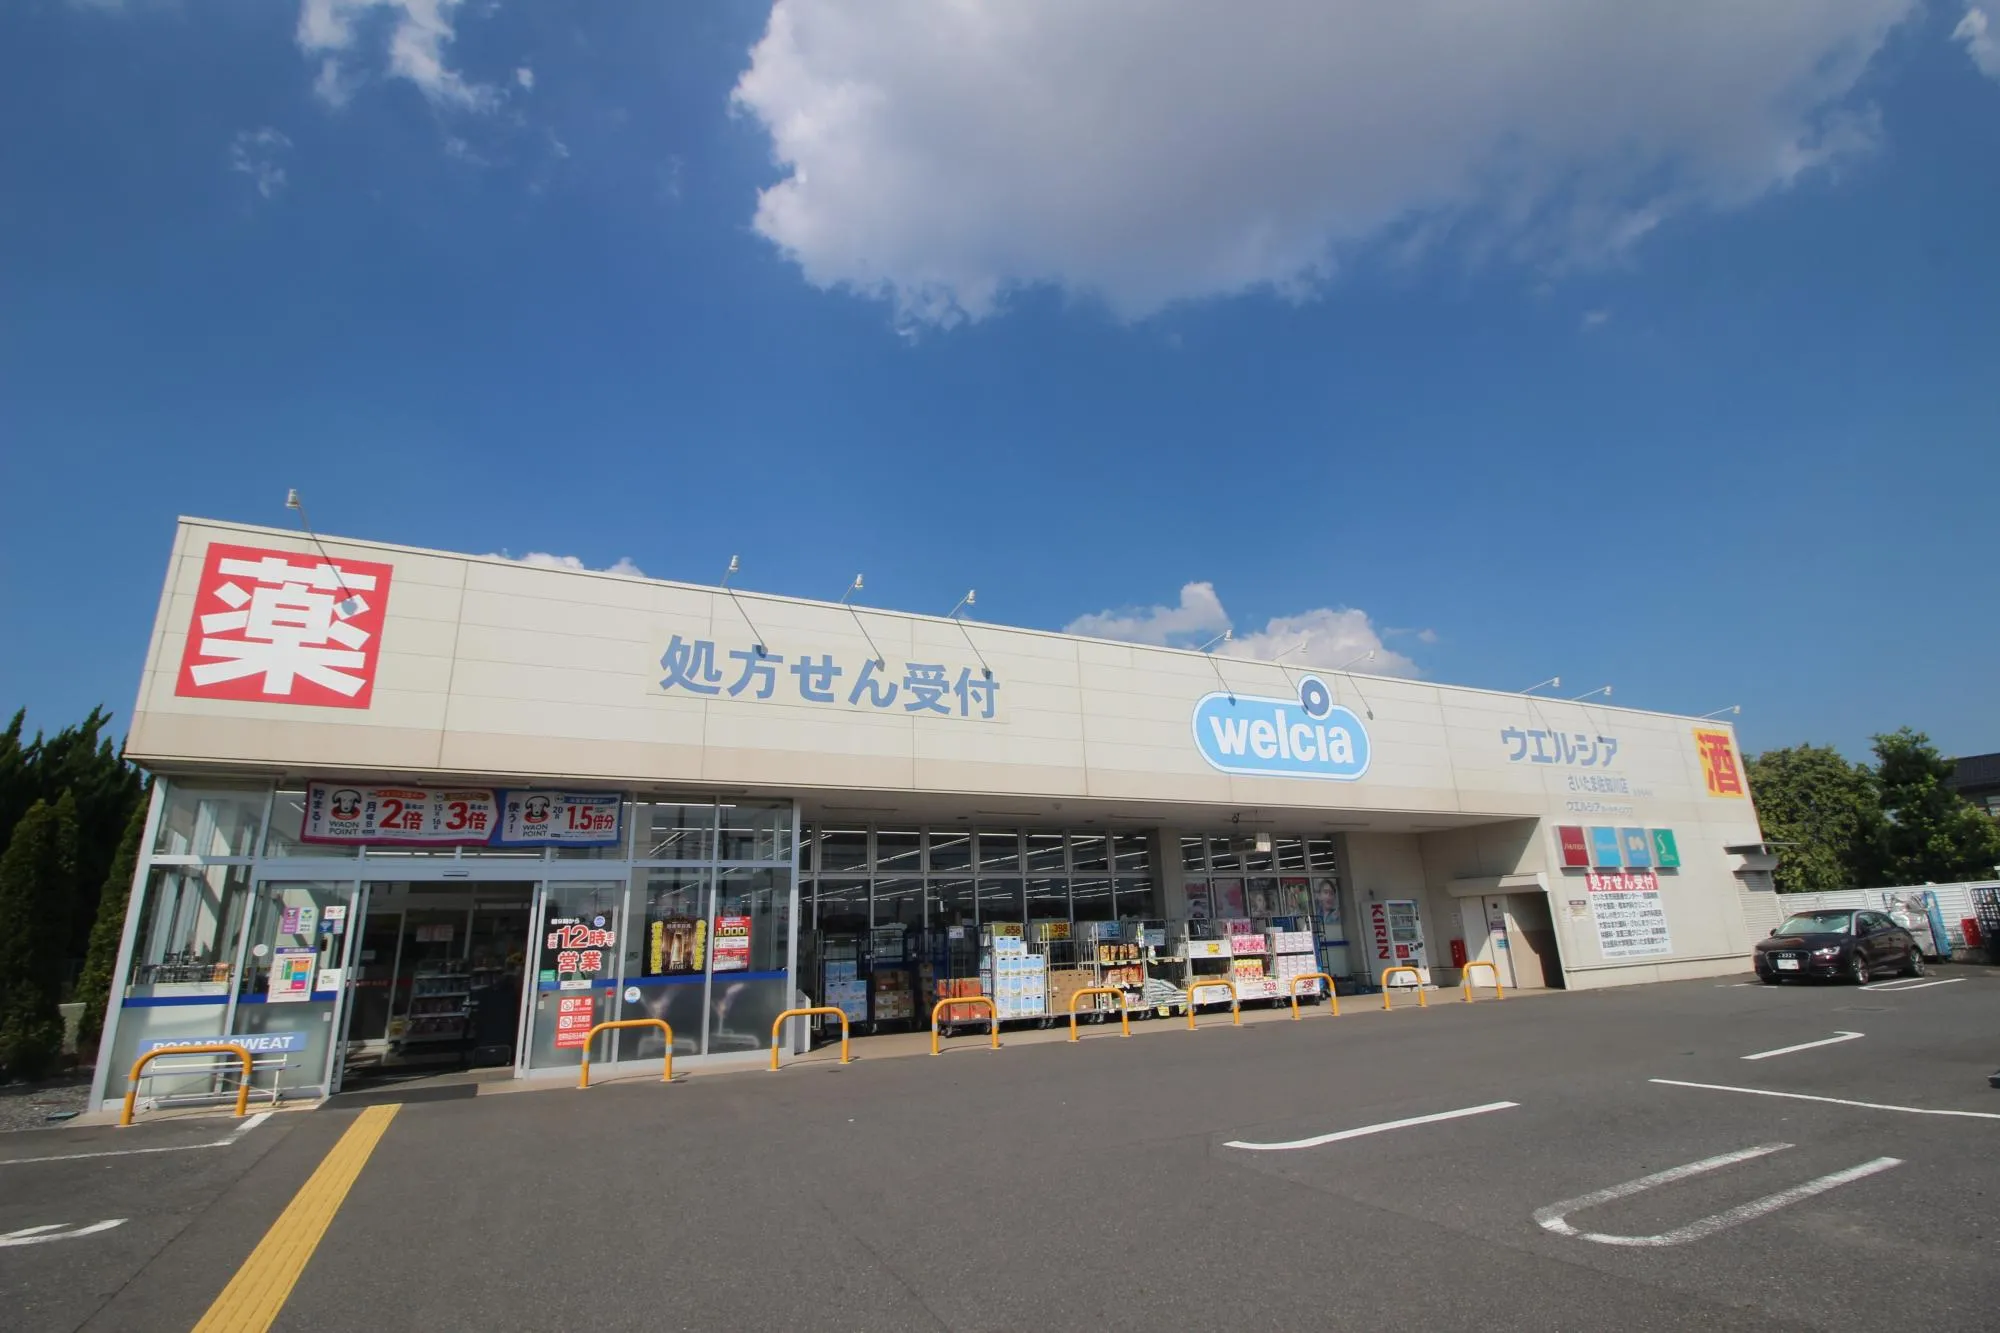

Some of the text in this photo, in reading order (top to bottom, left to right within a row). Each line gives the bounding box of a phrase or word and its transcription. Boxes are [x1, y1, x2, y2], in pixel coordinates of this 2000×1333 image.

[190, 556, 378, 697] 薬
[659, 634, 1001, 719] 処方せん受付
[1209, 708, 1355, 764] welcia
[1500, 726, 1618, 768] ウエルシア
[1697, 731, 1743, 795] 酒
[329, 821, 360, 829] WAON
[1590, 873, 1654, 891] 処方せん受付
[1371, 903, 1390, 960] KIRIN
[558, 951, 602, 973] 営業
[1263, 982, 1277, 991] 328
